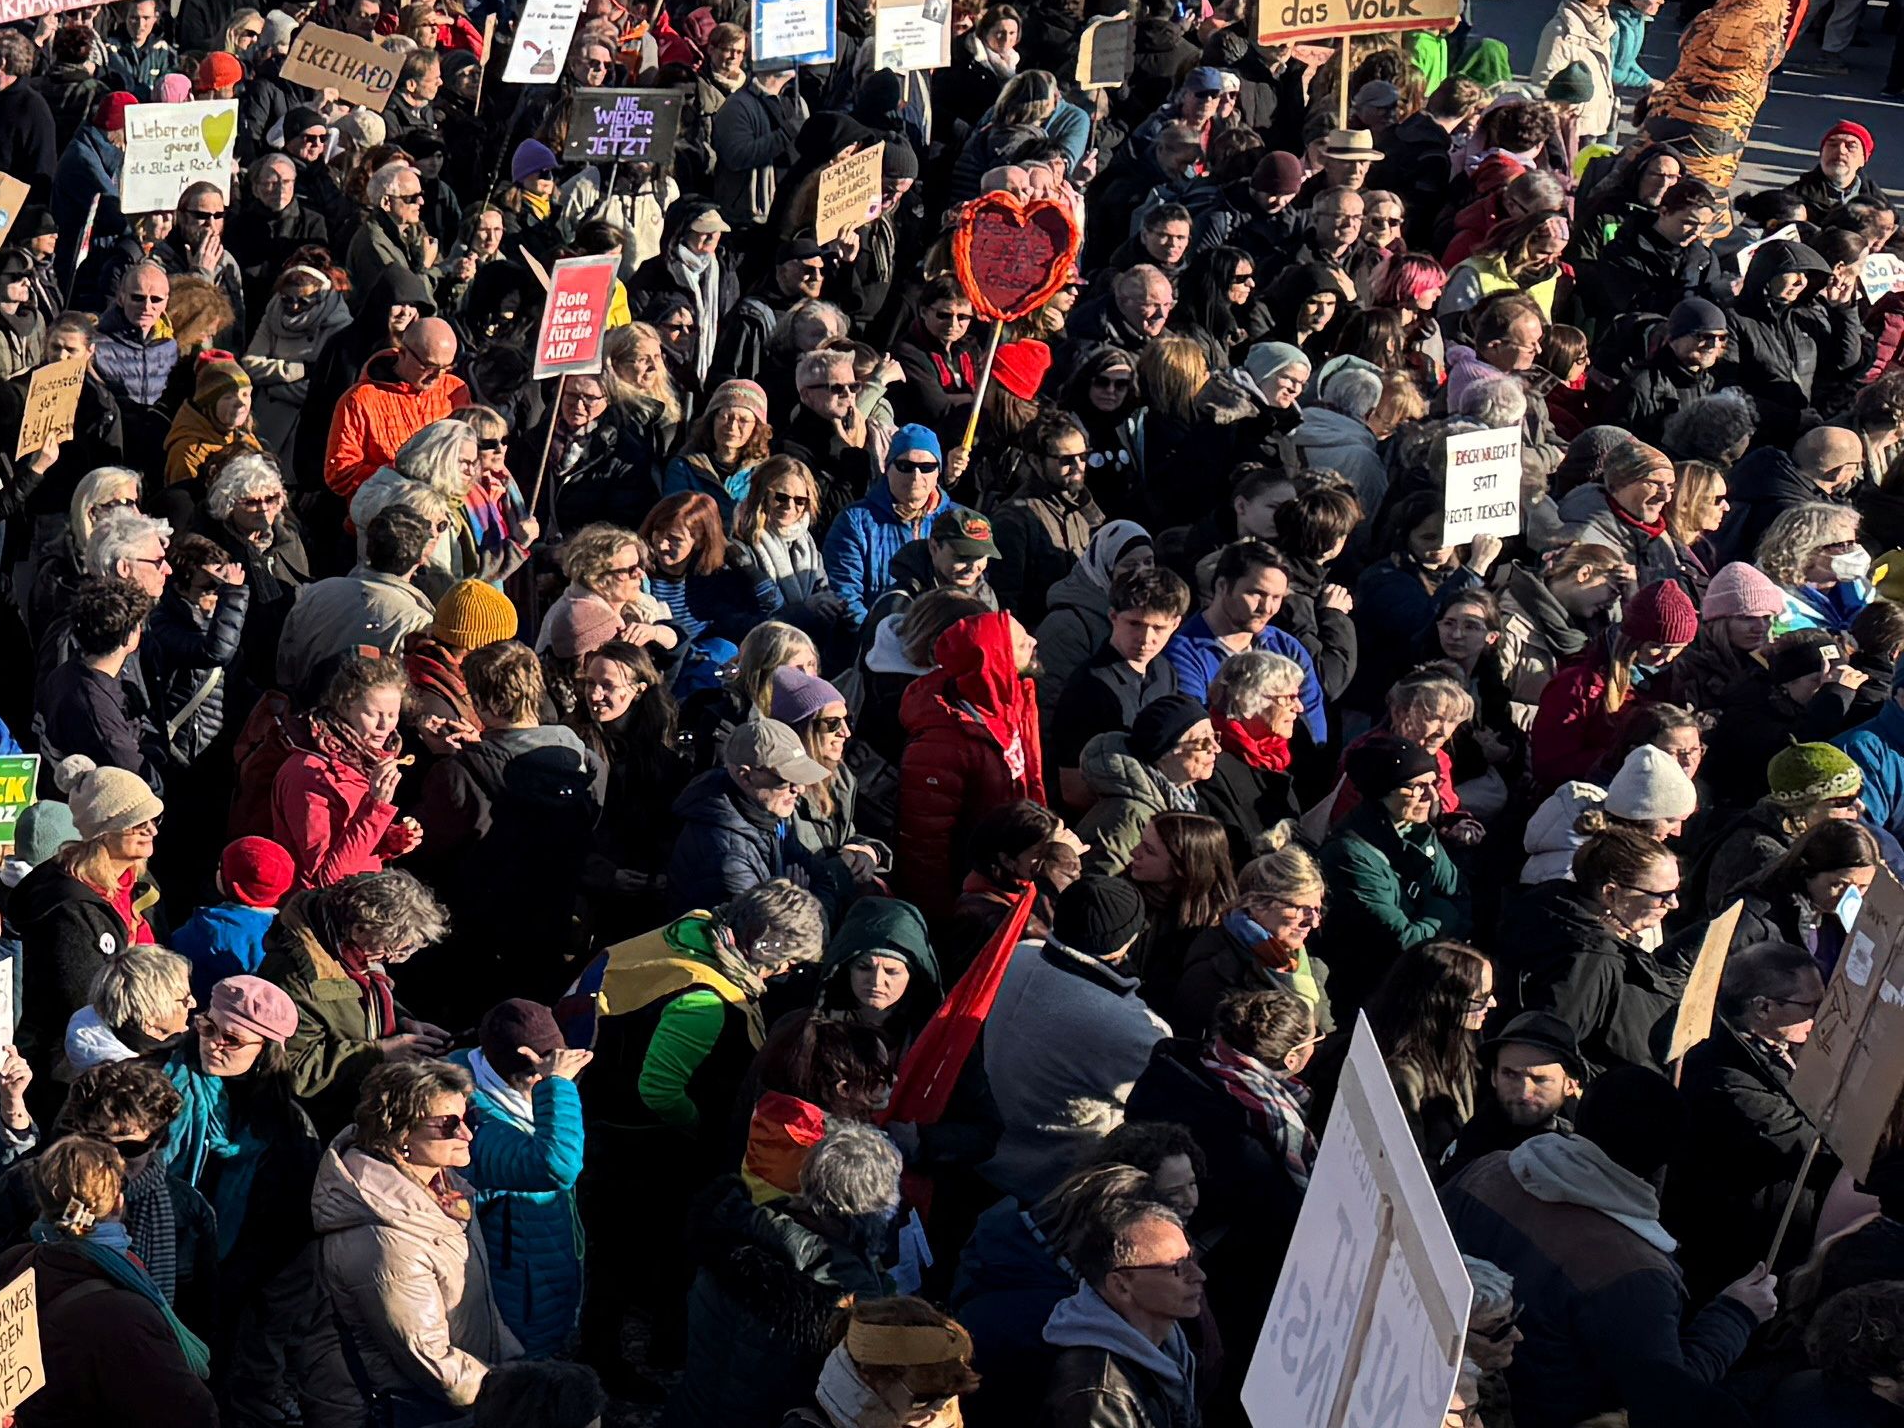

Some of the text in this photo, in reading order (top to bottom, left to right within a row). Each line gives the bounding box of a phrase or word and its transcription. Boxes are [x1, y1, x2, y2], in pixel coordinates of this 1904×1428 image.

[615, 95, 640, 111] NIE
[596, 110, 654, 126] WIEDER
[130, 120, 200, 141] Lieber ein
[609, 125, 635, 138] IST
[586, 136, 652, 157] JETZT
[148, 158, 186, 175] Black
[189, 158, 222, 173] Rock
[555, 290, 590, 308] Rote
[552, 307, 592, 324] Karte
[548, 322, 594, 342] für die
[544, 342, 578, 361] AfD!
[1472, 473, 1498, 492] STATT
